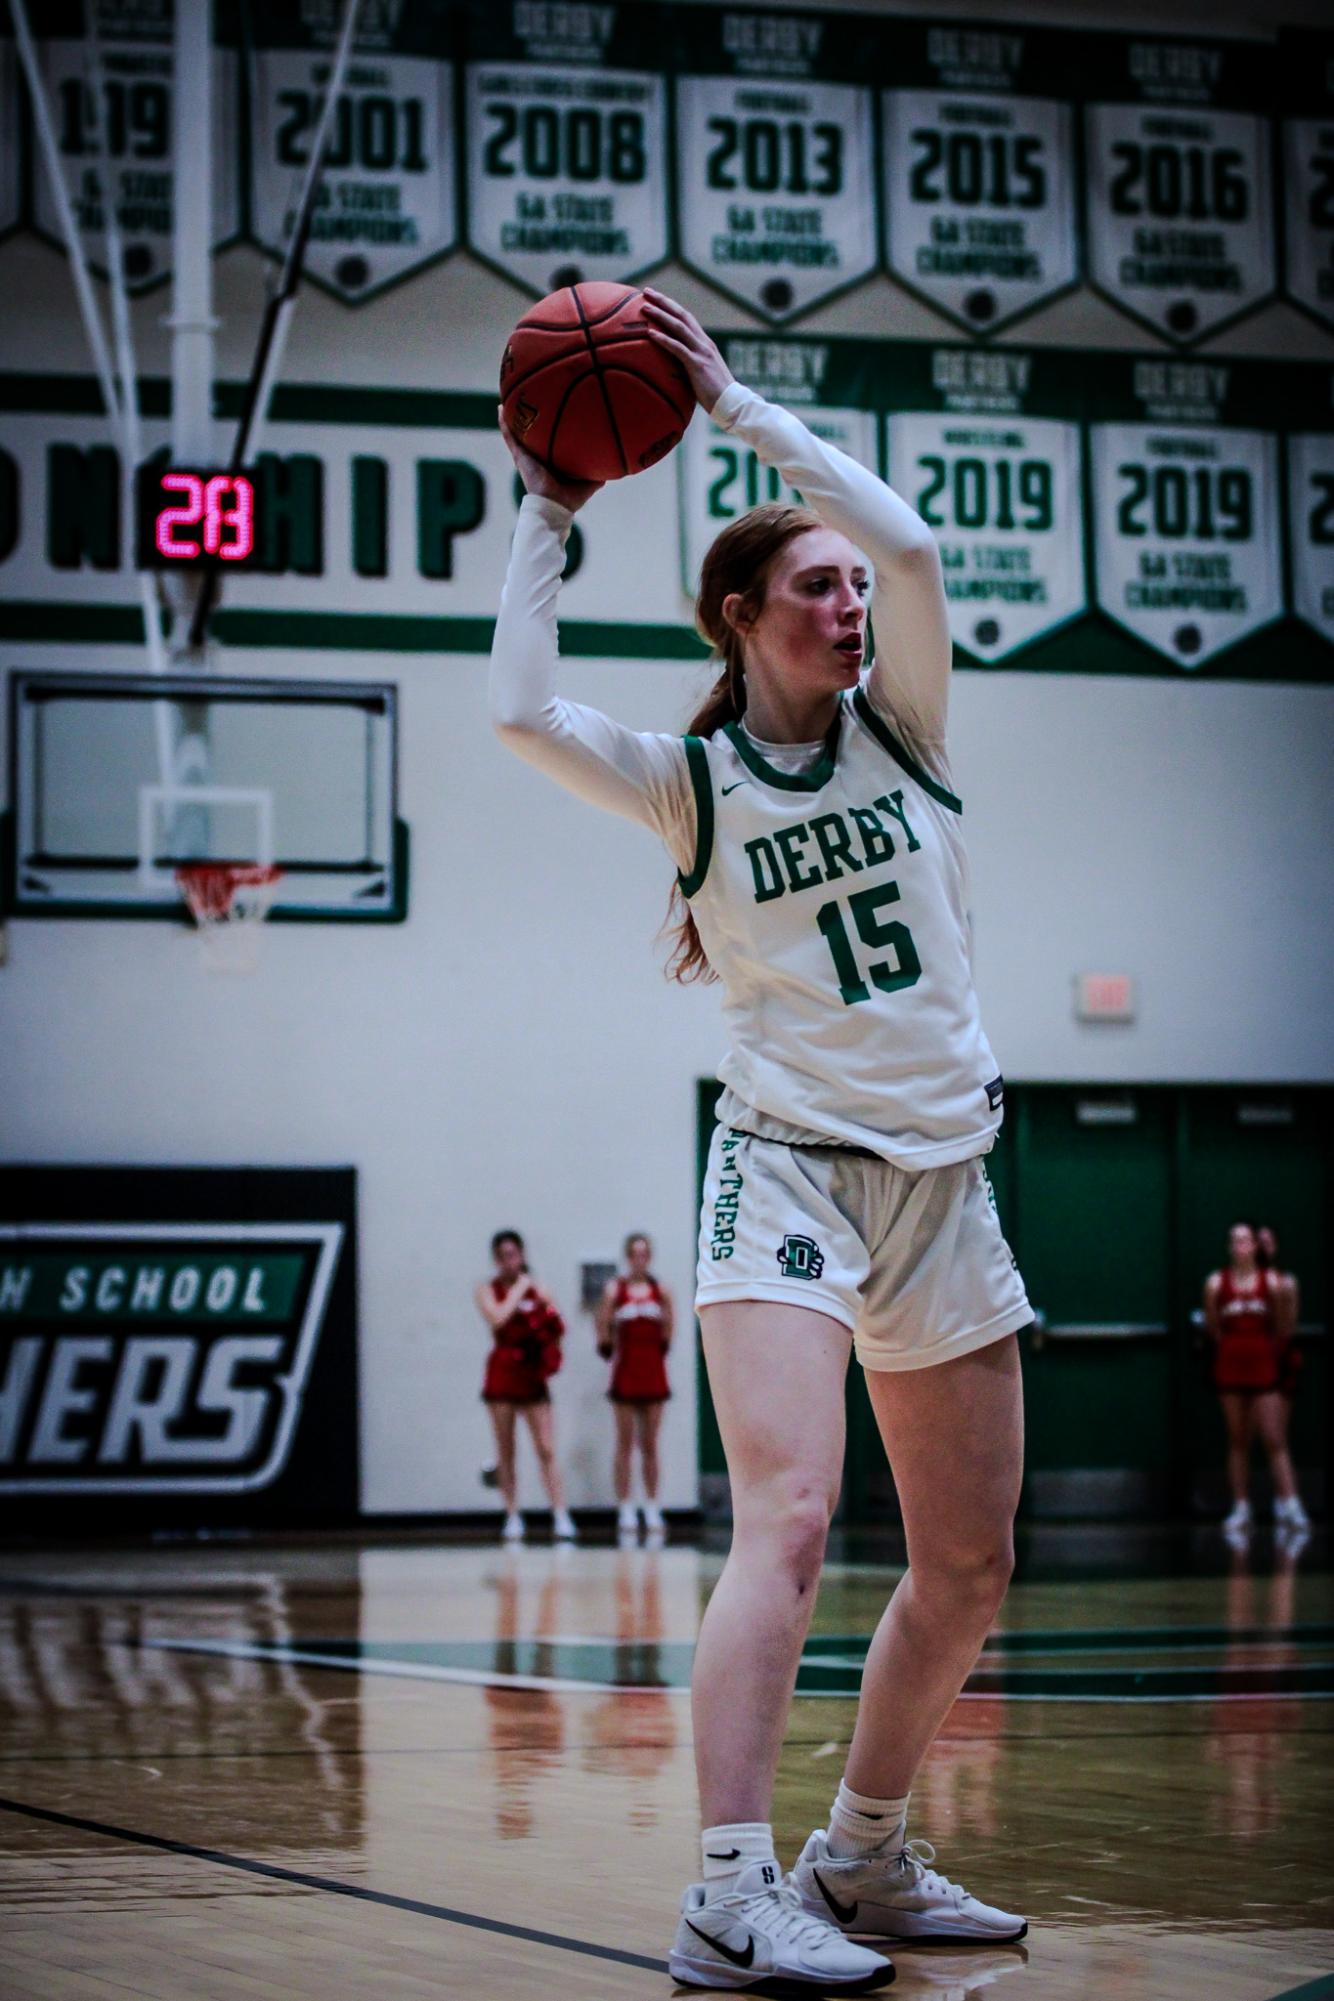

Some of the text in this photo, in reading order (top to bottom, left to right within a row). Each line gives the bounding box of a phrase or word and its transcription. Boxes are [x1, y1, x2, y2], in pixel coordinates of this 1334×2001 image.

[485, 104, 646, 182] 2008
[708, 117, 842, 194] 2013
[910, 129, 1046, 209] 2015
[1111, 142, 1247, 221] 2016
[555, 194, 613, 223] STATE
[763, 207, 821, 234] STATE
[500, 223, 628, 254] CHAMPIONS
[966, 219, 1023, 246] STATE
[1164, 230, 1224, 259] STATE
[712, 237, 839, 266] CHAMPIONS
[918, 247, 1041, 280] CHAMPIONS
[1121, 259, 1242, 290] CHAMPIONS
[919, 456, 1052, 530] 2019
[1118, 463, 1251, 540] 2019
[975, 545, 1030, 573] STATE
[1174, 552, 1231, 580] STATE
[1125, 582, 1247, 611] CHAMPIONS
[744, 789, 920, 904] DERBY
[816, 881, 922, 1005] 15
[58, 1264, 266, 1313] SCHOOL
